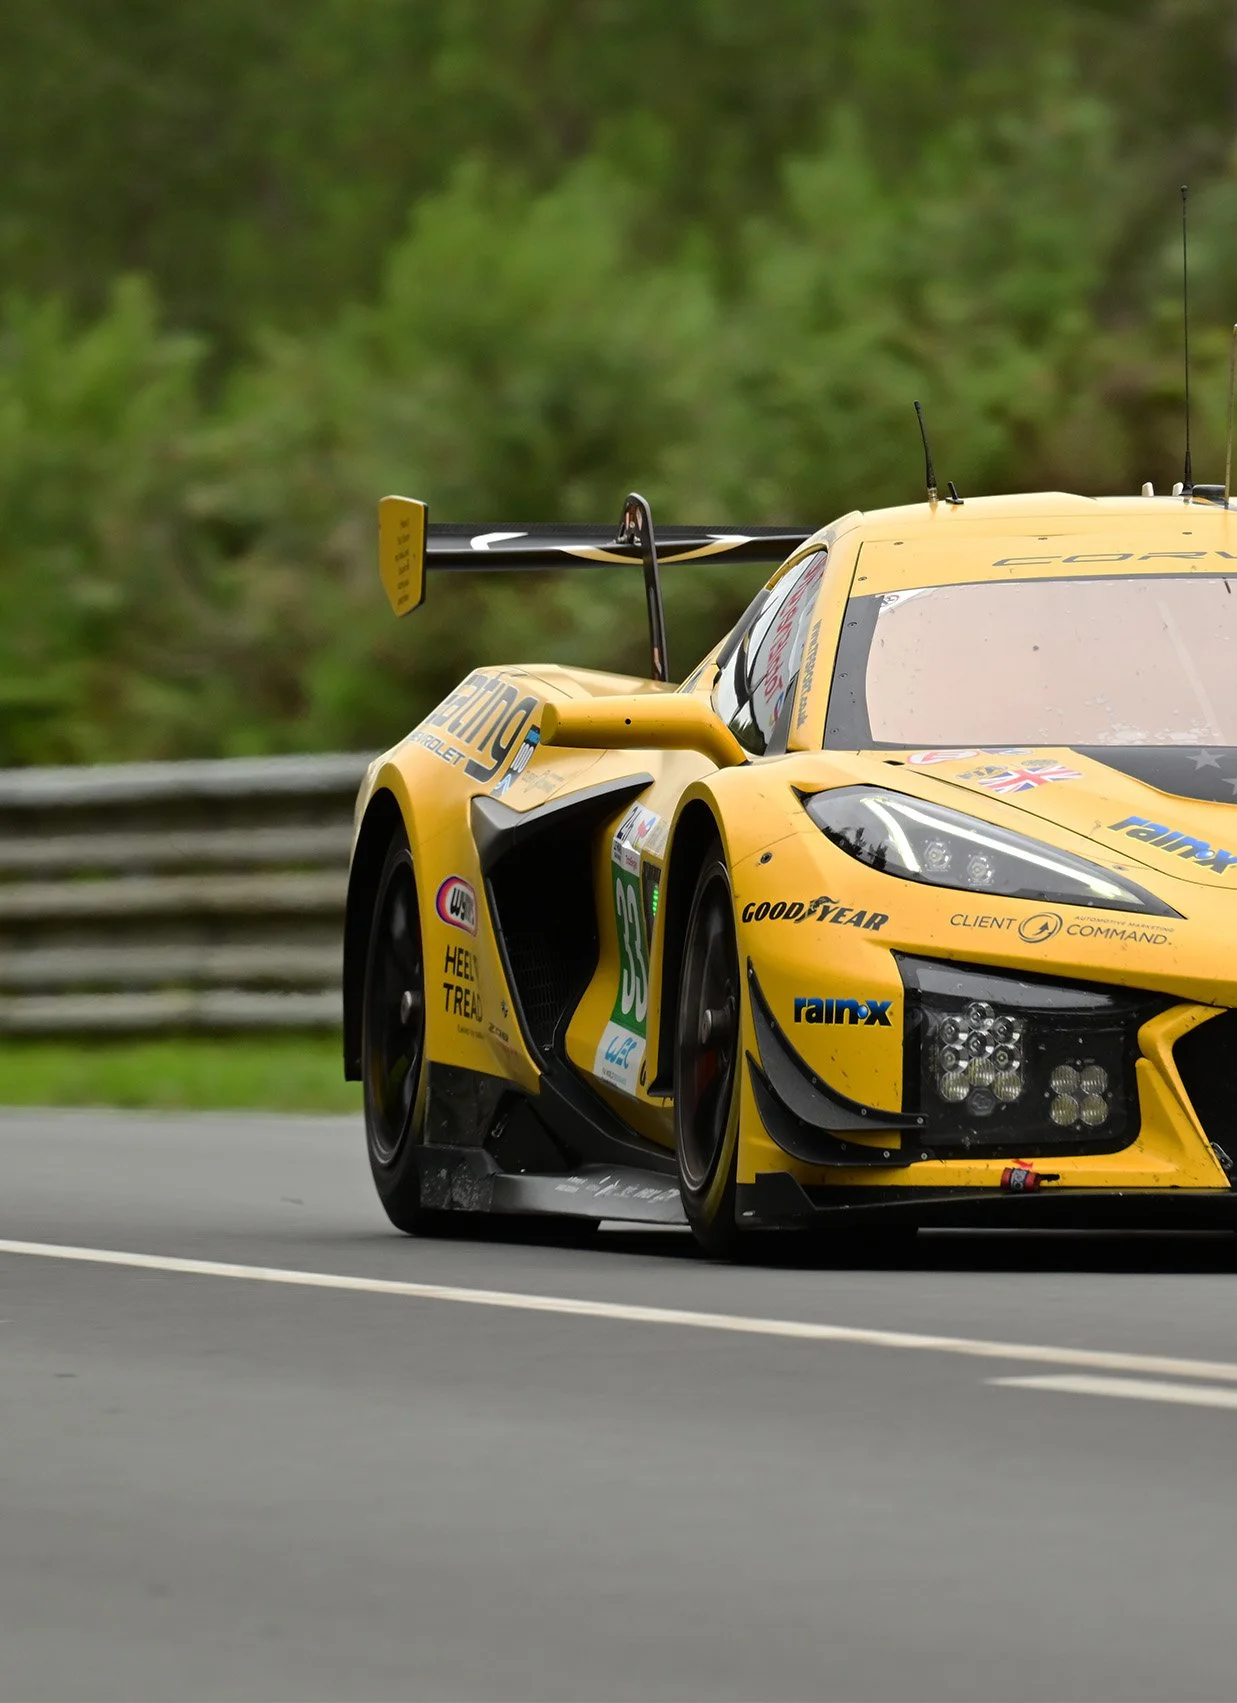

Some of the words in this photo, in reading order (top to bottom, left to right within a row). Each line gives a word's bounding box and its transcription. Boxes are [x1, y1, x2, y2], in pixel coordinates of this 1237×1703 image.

[741, 896, 889, 932] GOODYEAR
[950, 913, 1017, 930] CLIENT
[616, 877, 648, 1023] 33
[442, 982, 483, 1023] TREAD
